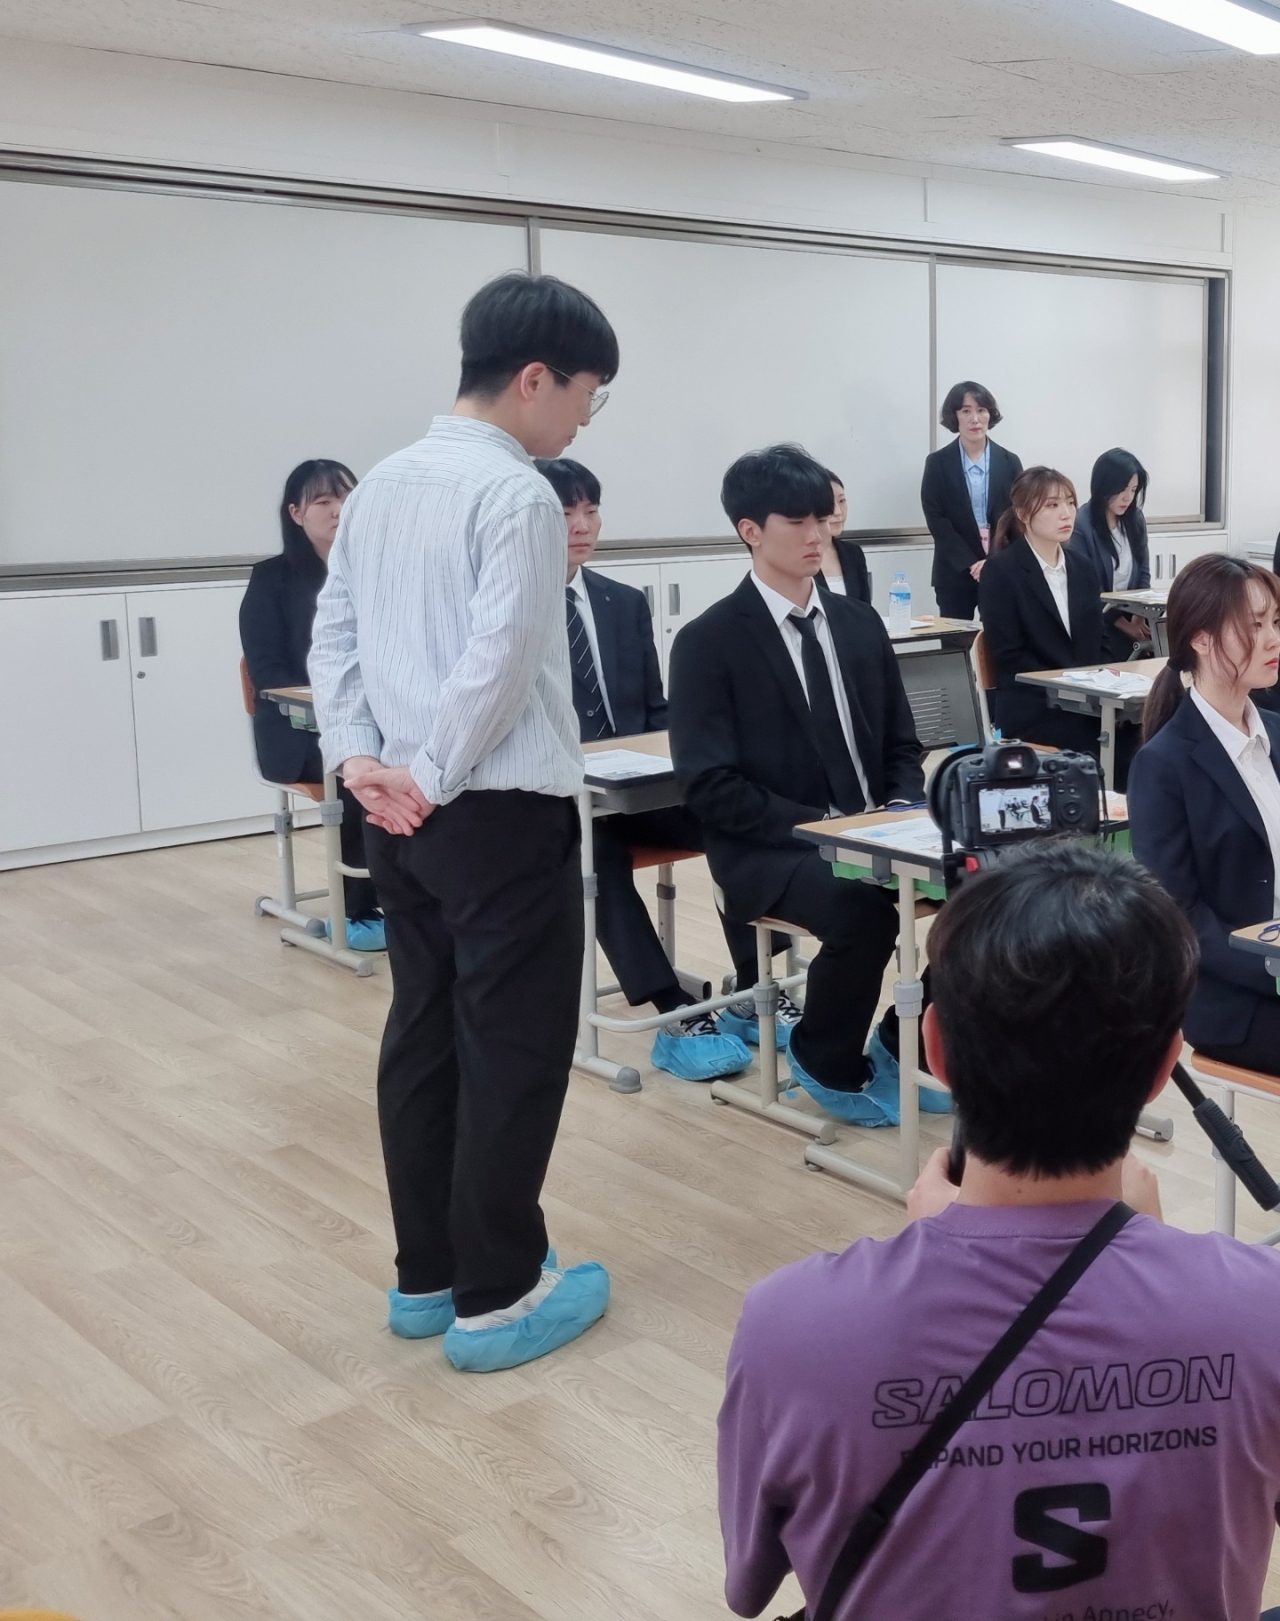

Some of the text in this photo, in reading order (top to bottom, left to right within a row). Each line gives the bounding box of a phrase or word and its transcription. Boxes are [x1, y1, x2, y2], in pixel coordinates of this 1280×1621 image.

[1013, 1438, 1081, 1464] YOUR
[1088, 1426, 1217, 1457] HORIZONS
[1012, 1482, 1111, 1594] S
